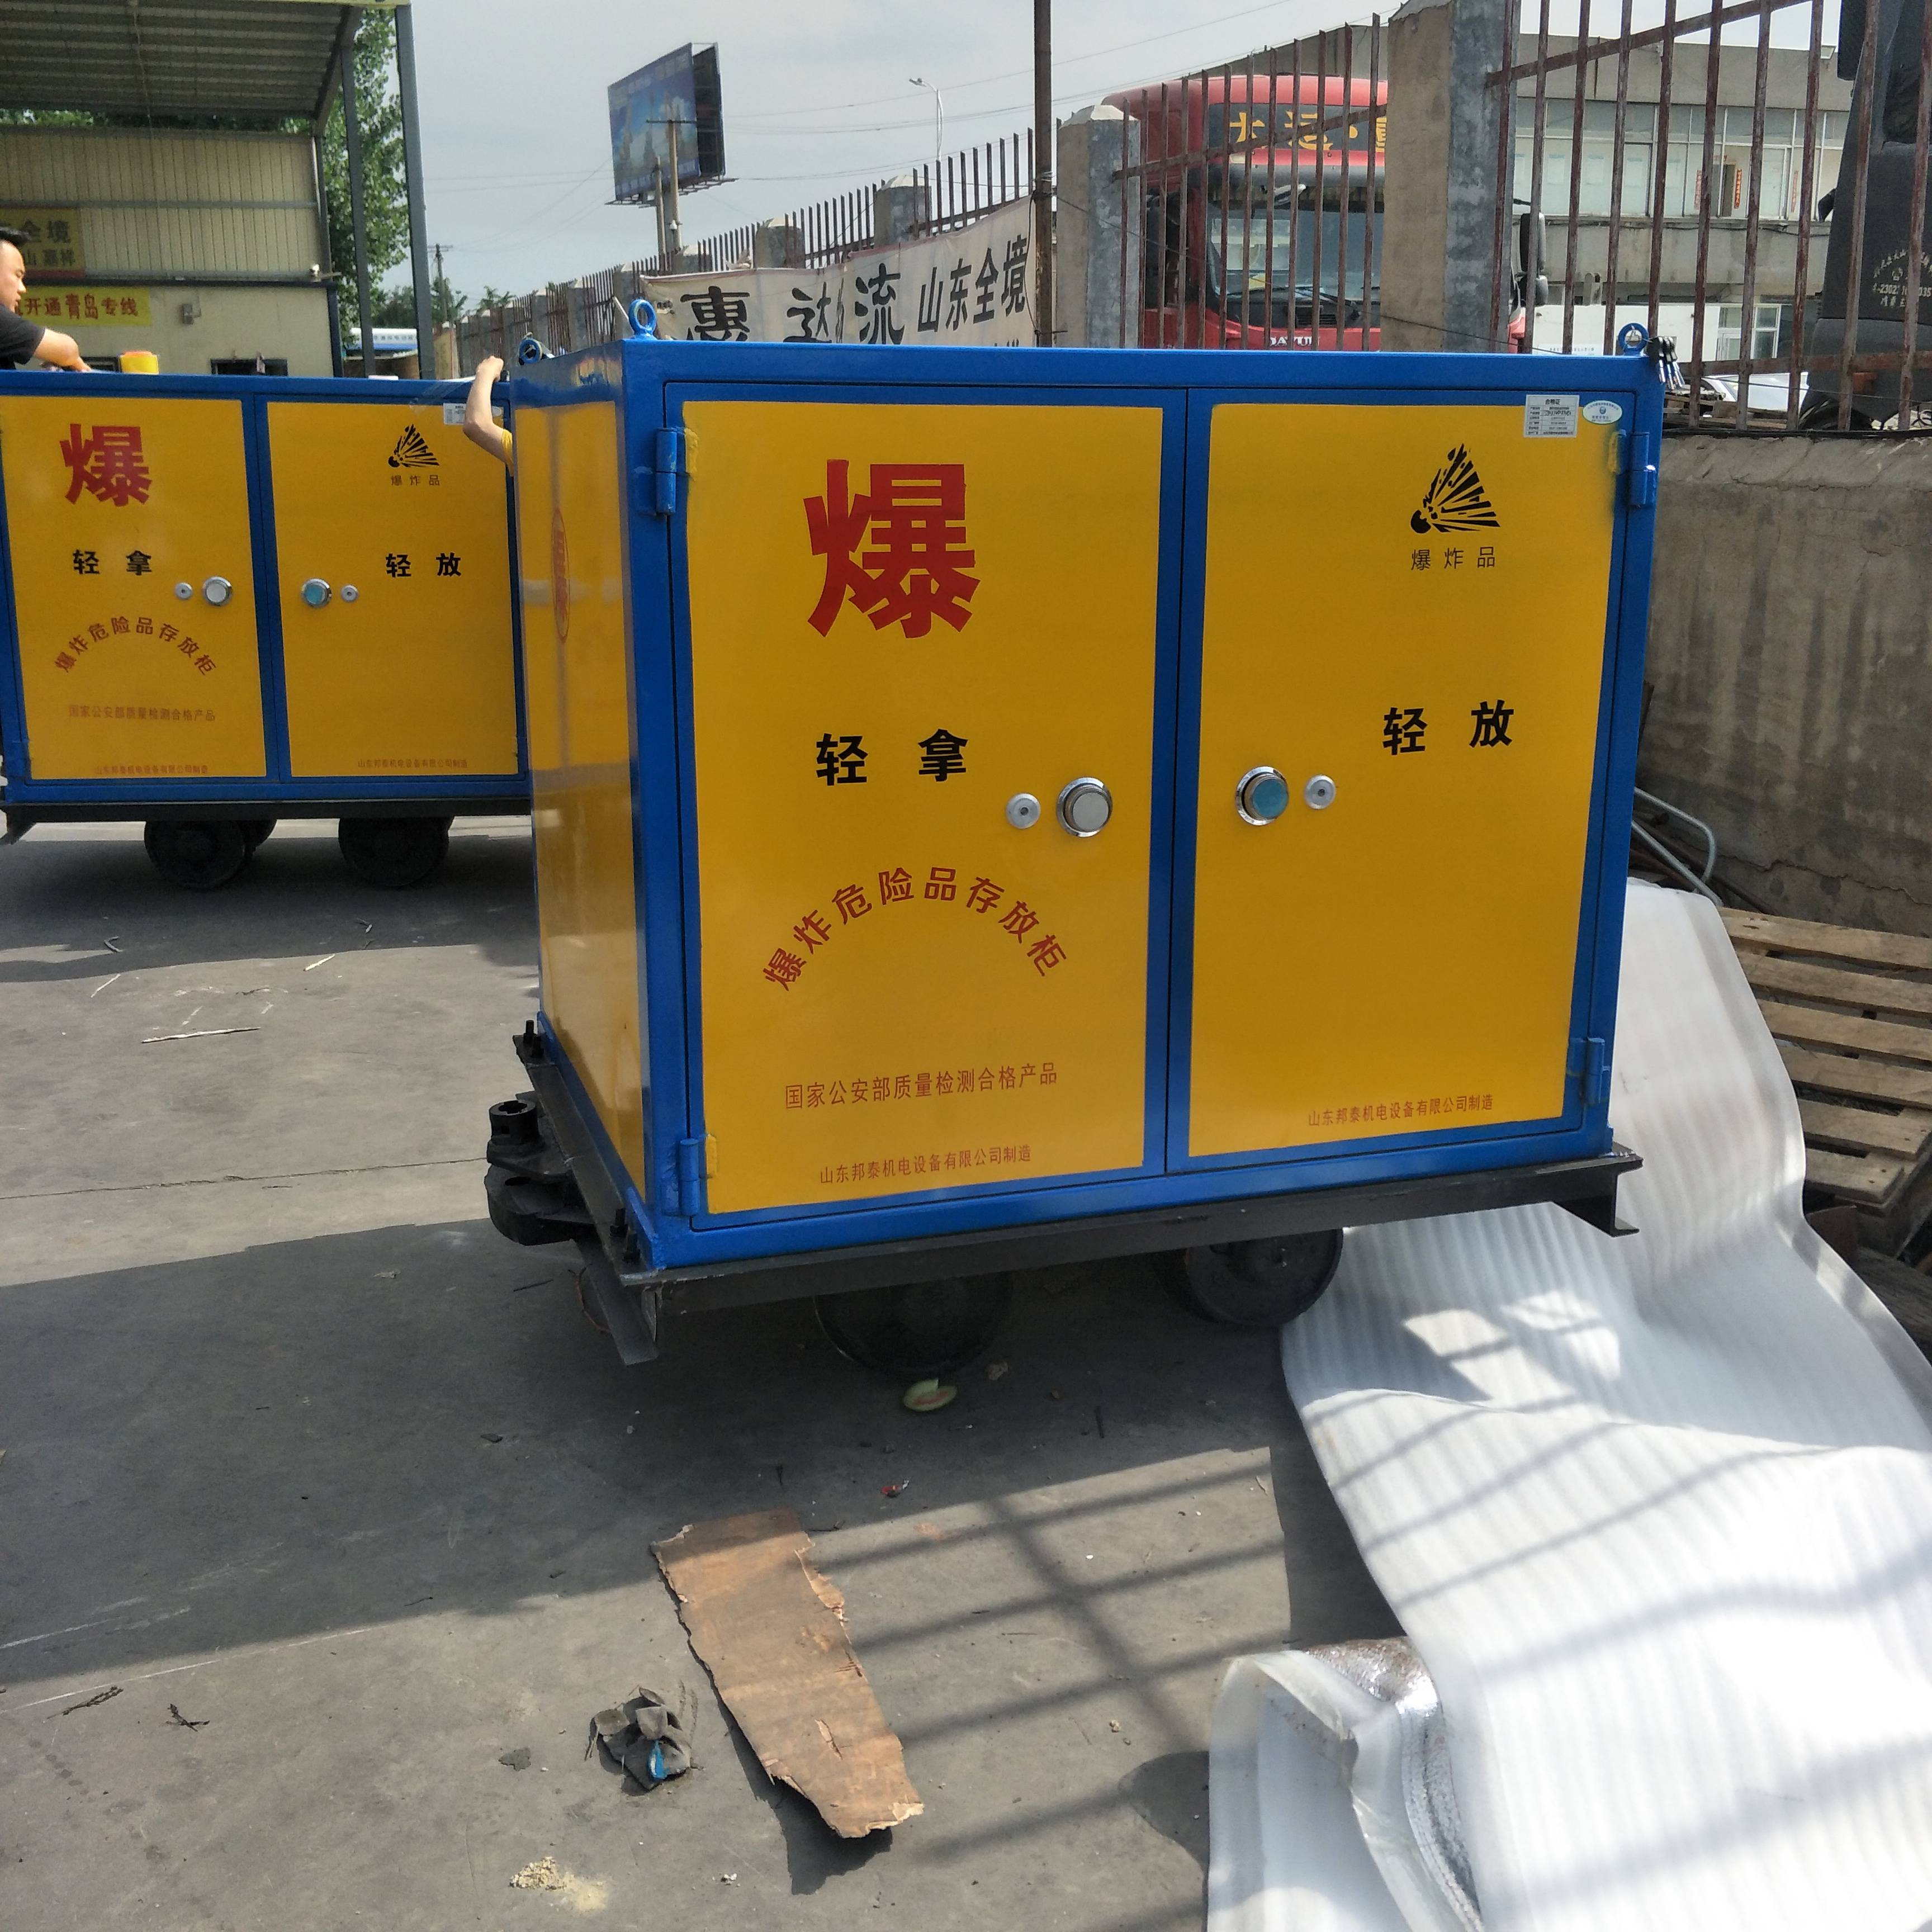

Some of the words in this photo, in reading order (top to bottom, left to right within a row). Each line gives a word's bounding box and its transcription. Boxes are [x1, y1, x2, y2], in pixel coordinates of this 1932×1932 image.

[917, 235, 1028, 333] 山东全境
[60, 424, 152, 506] 爆
[391, 475, 440, 486] 爆炸品
[803, 459, 981, 638] 爆
[1410, 546, 1496, 571] 爆炸品
[54, 615, 217, 676] 爆炸危险品存放柜
[763, 866, 1067, 992] 爆炸危险品存放柜
[785, 1062, 1058, 1110] 国家公安部质量检测合格产品
[1308, 1093, 1494, 1127] 山东邦泰机电设备有限公司制造
[820, 1144, 1032, 1185] 山东邦泰机电设备有限公司制造
